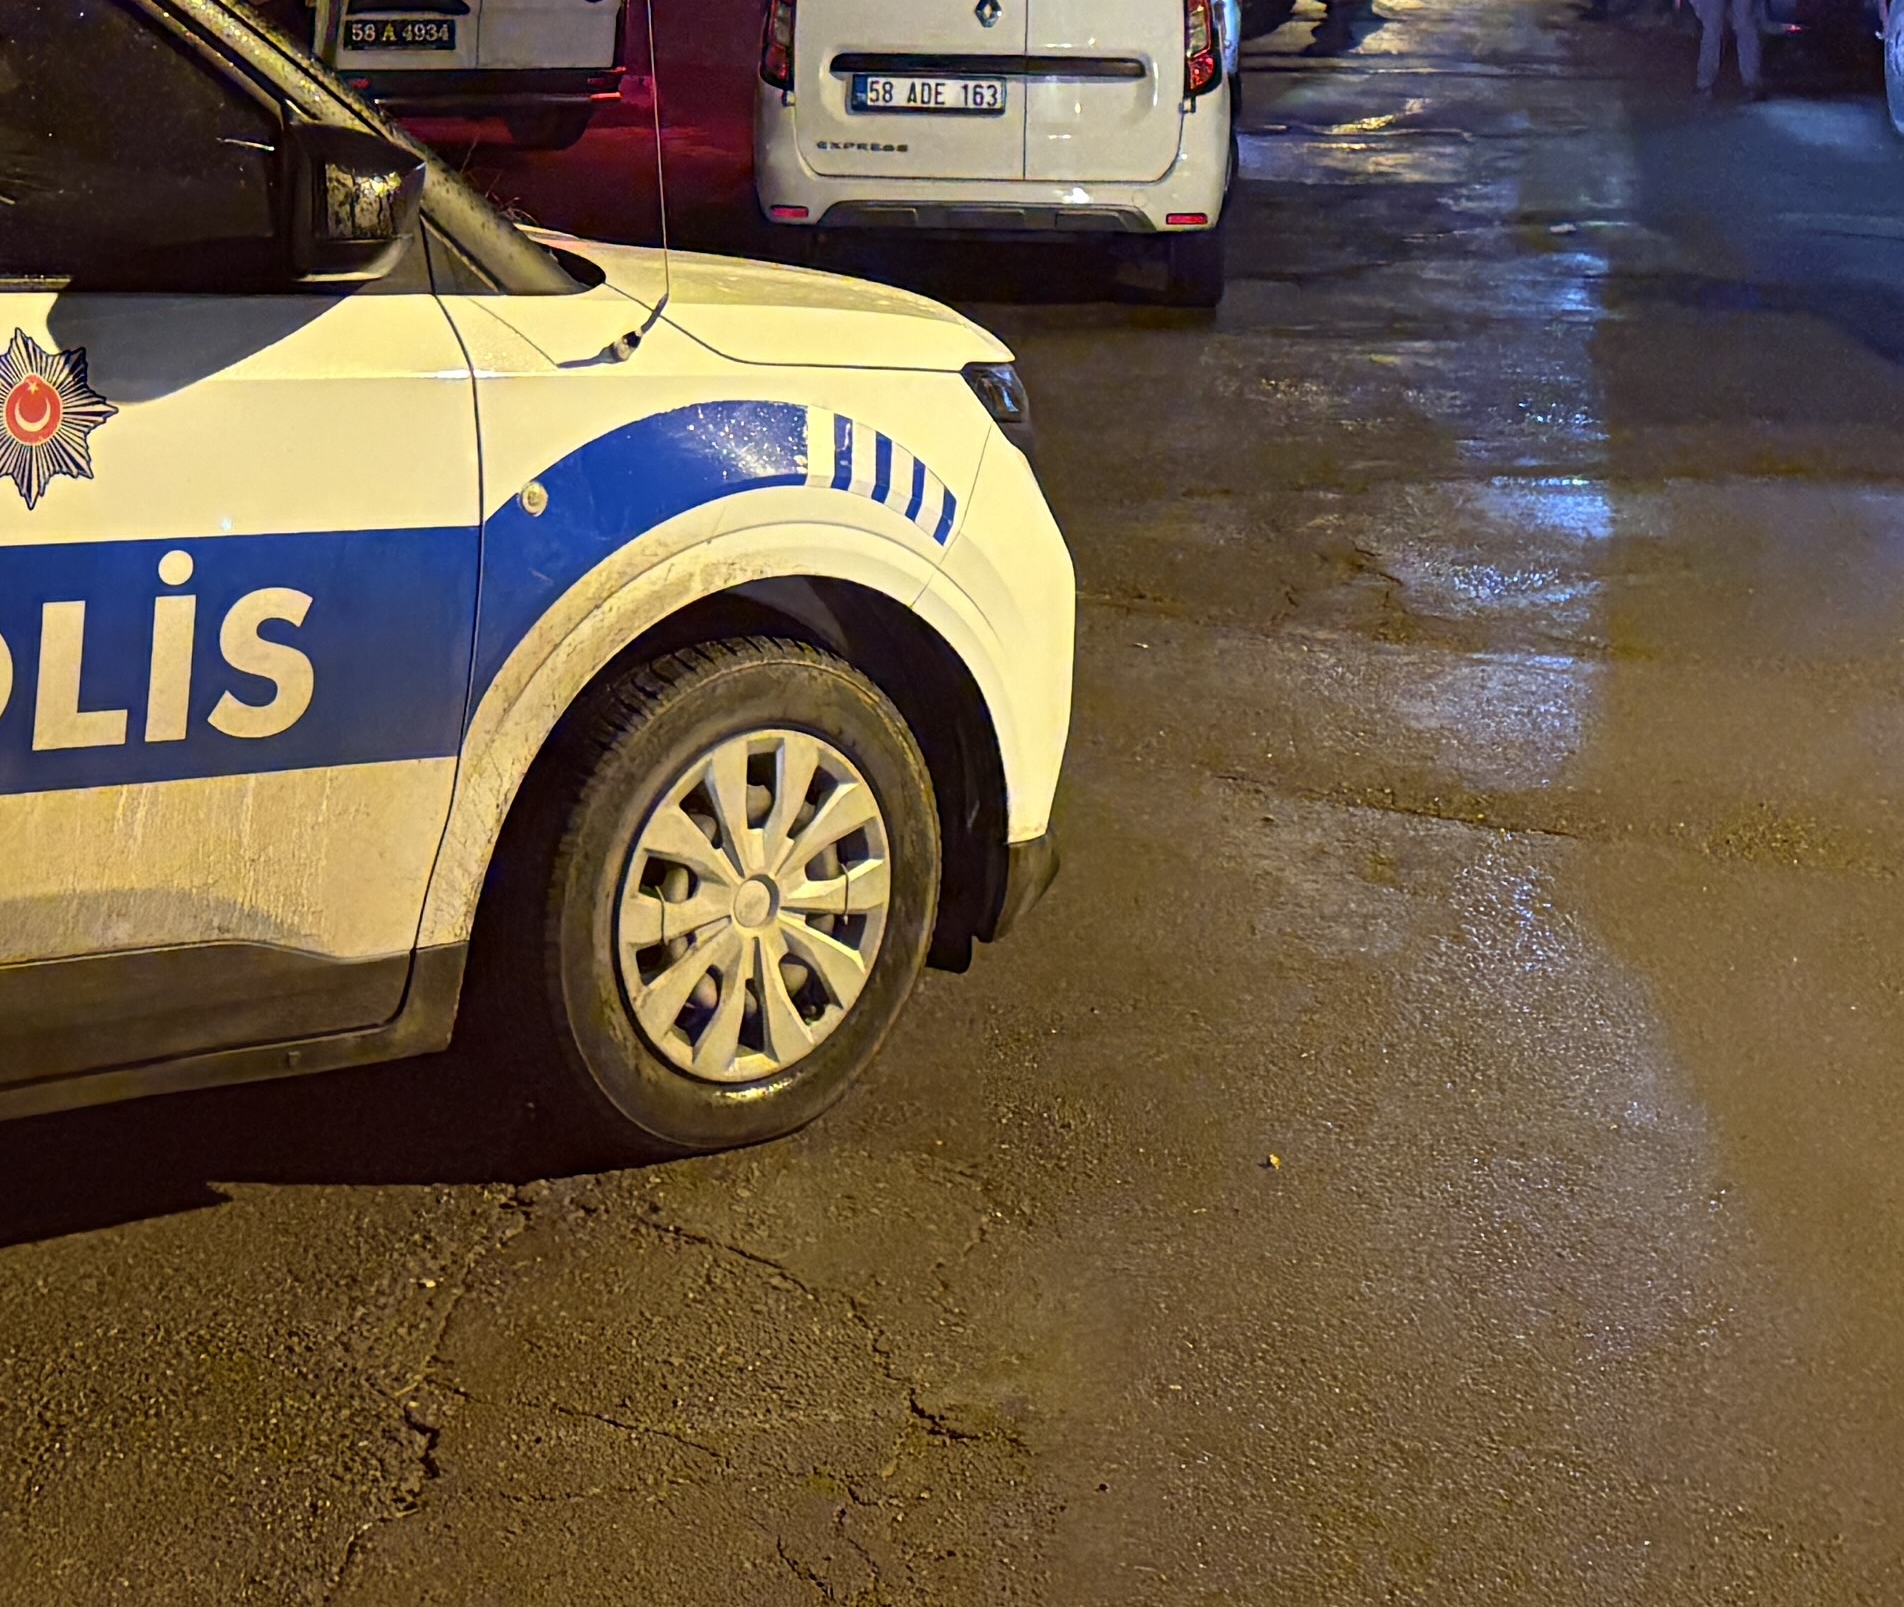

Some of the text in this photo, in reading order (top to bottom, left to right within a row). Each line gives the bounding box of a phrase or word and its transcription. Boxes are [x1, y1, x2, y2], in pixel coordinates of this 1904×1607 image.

[352, 22, 449, 42] 58 A 4934
[868, 79, 999, 108] 58 ADE 163
